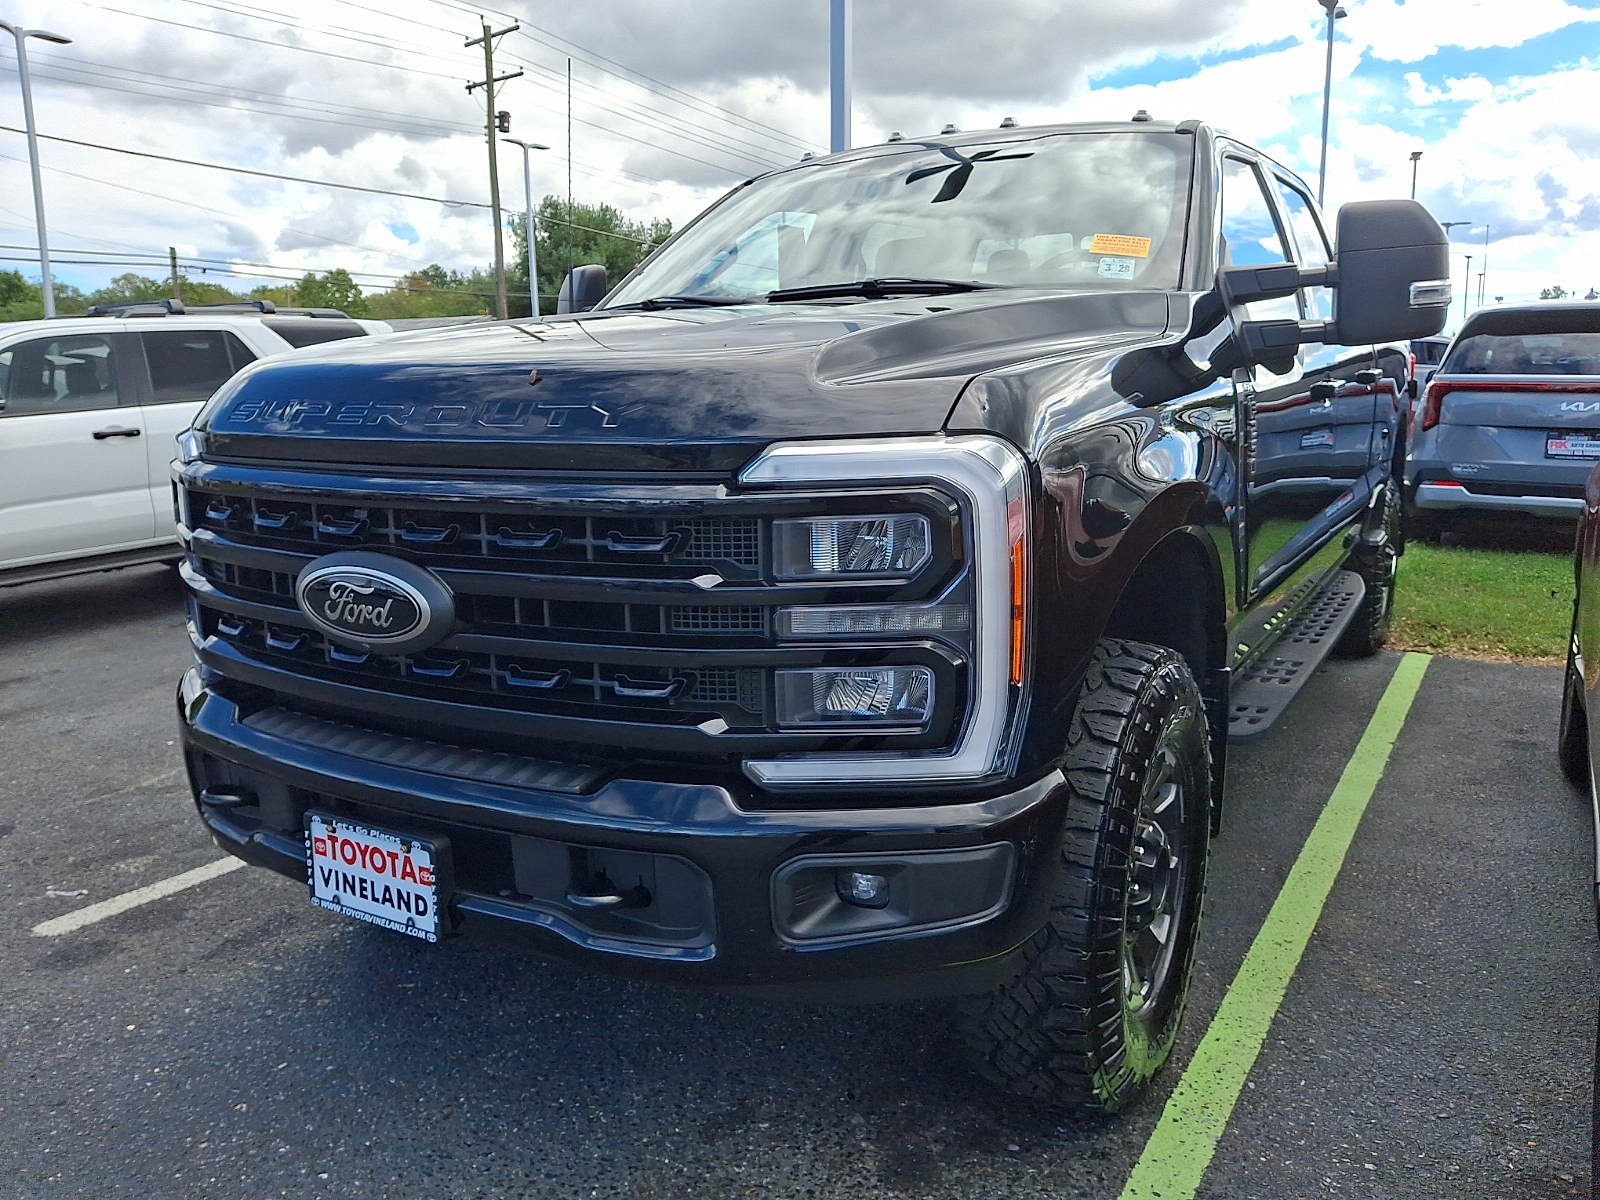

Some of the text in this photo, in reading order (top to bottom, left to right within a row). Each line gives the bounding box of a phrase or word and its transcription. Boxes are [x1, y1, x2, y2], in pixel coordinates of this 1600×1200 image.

[1104, 263, 1112, 272] 3
[228, 398, 647, 428] SUPER DUTY
[1560, 401, 1600, 411] KIA
[1550, 441, 1569, 449] RK
[324, 581, 394, 628] Ford
[332, 820, 401, 844] Let's Go Places
[304, 830, 314, 886] TOYOTA
[327, 833, 419, 884] TOYOTA
[318, 865, 429, 917] VINELAND
[429, 864, 439, 924] TOYOTA
[320, 899, 426, 940] WWW.TOYOTAVINELAND.COM
